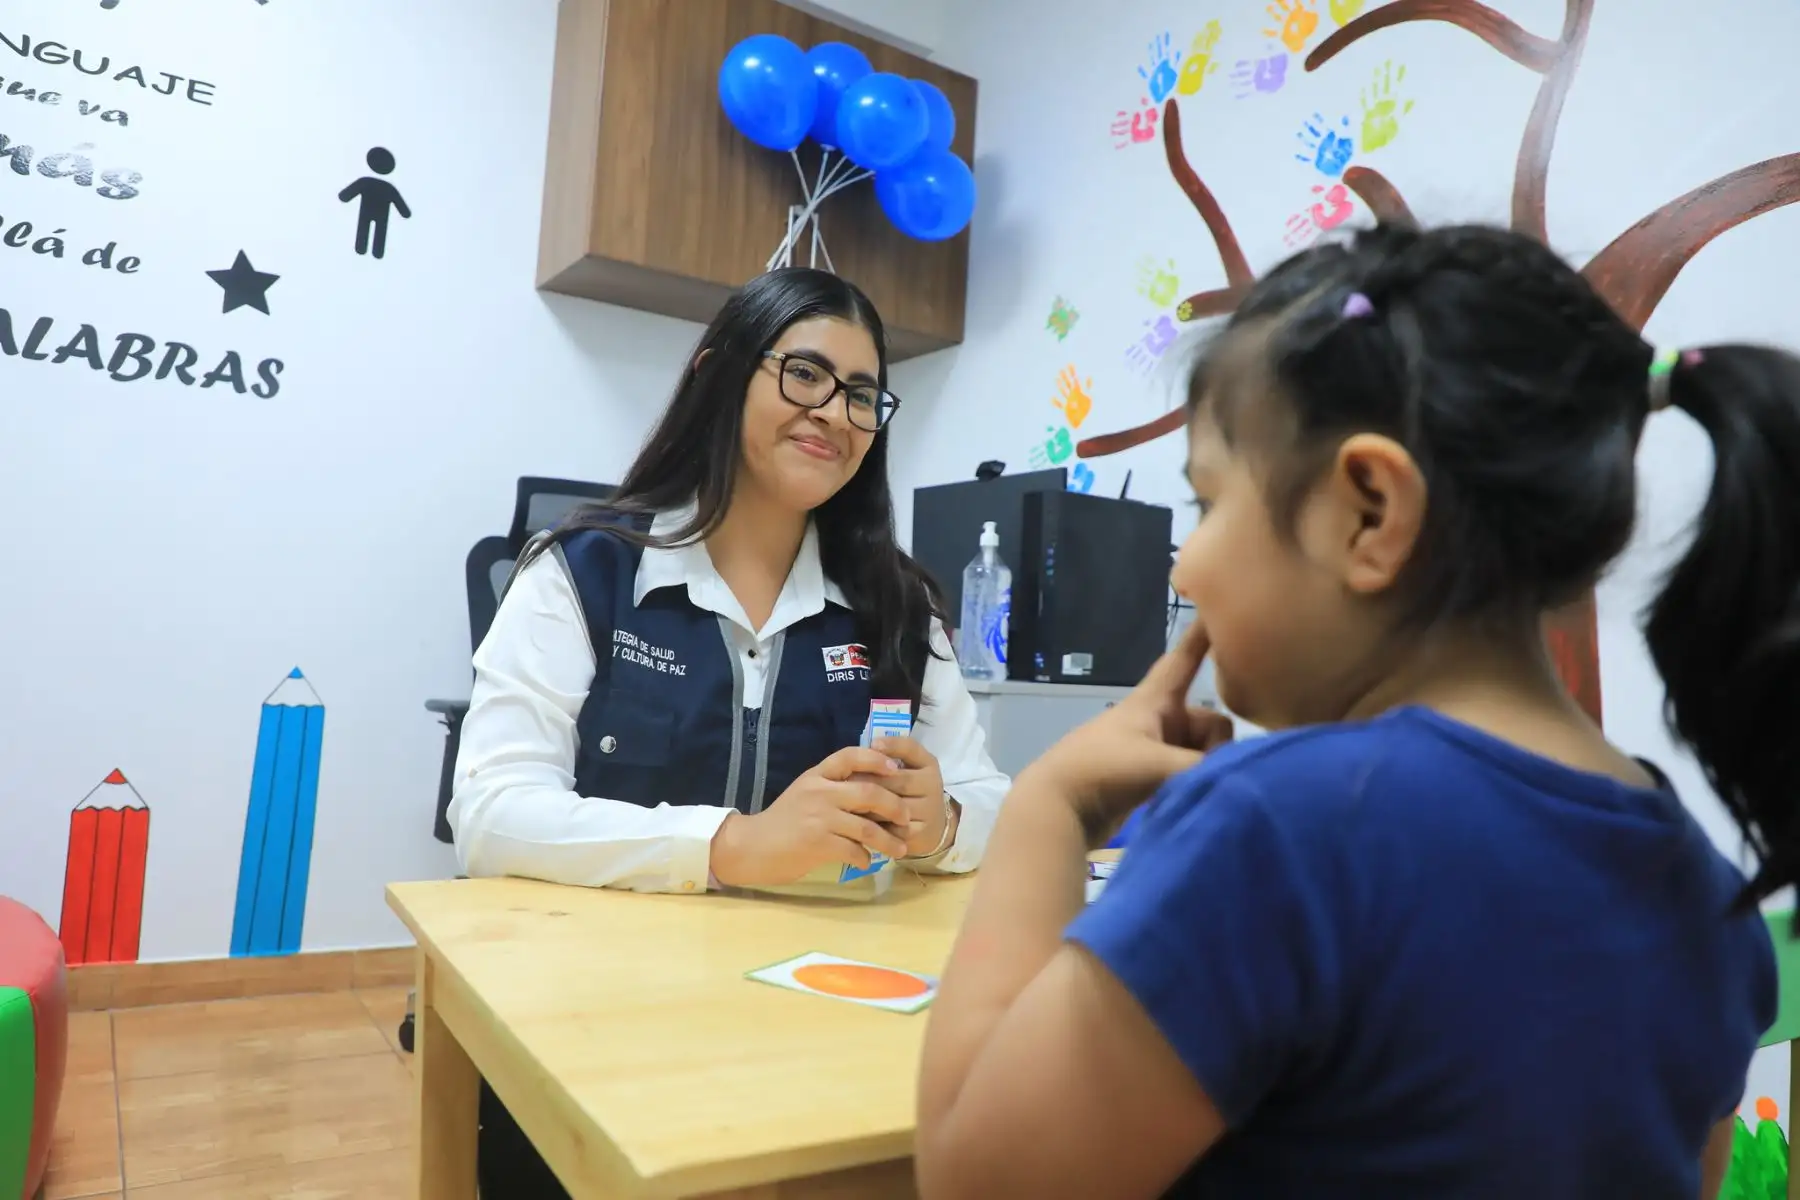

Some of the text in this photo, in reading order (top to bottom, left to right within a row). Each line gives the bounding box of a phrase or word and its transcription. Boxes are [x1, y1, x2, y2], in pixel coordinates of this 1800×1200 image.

[0, 76, 129, 127] ue va
[0, 215, 141, 274] lá de
[612, 645, 687, 676] Y CULTURA DE PAZ
[640, 640, 649, 653] DE
[650, 646, 675, 660] SALUD
[827, 670, 855, 683] DIRIS
